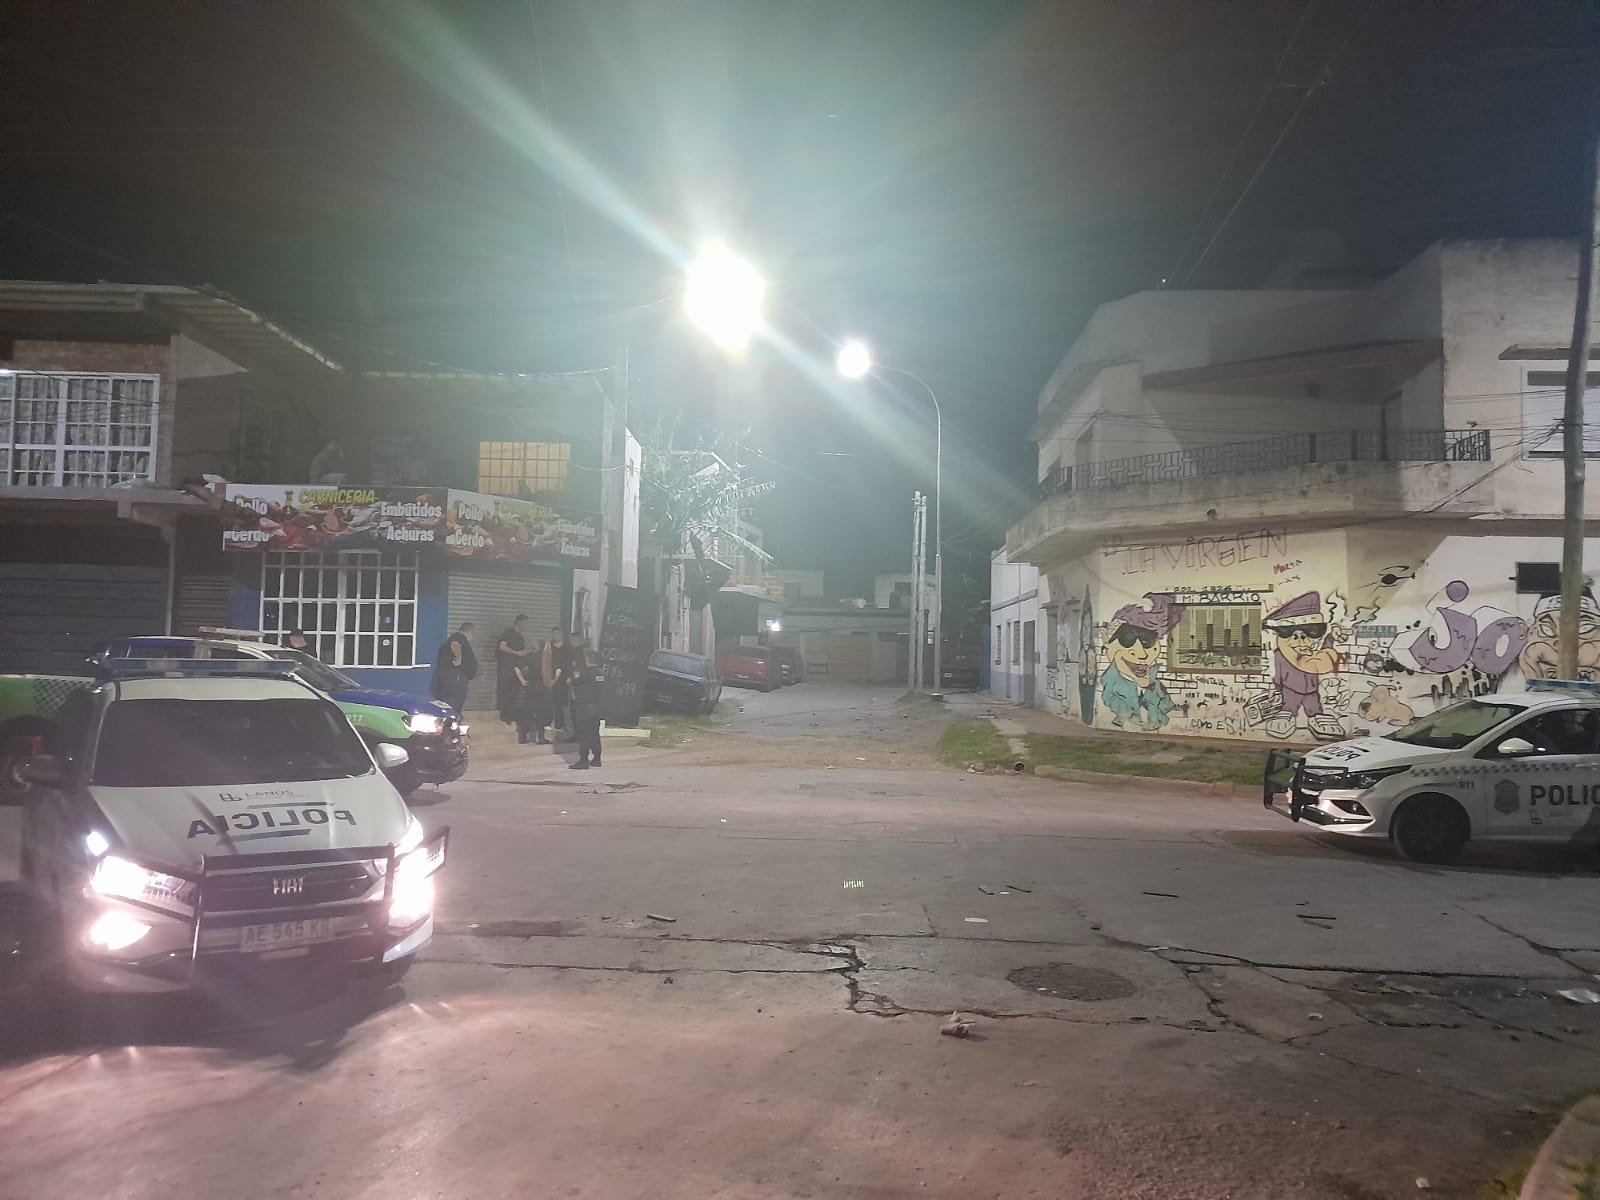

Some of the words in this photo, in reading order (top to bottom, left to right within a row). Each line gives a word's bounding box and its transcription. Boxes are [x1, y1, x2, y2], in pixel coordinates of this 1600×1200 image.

[298, 489, 375, 506] CARNICERIA
[379, 501, 442, 518] Embutidos
[458, 502, 484, 521] Pollo
[385, 525, 435, 542] Achuras
[455, 529, 485, 547] Cerdo
